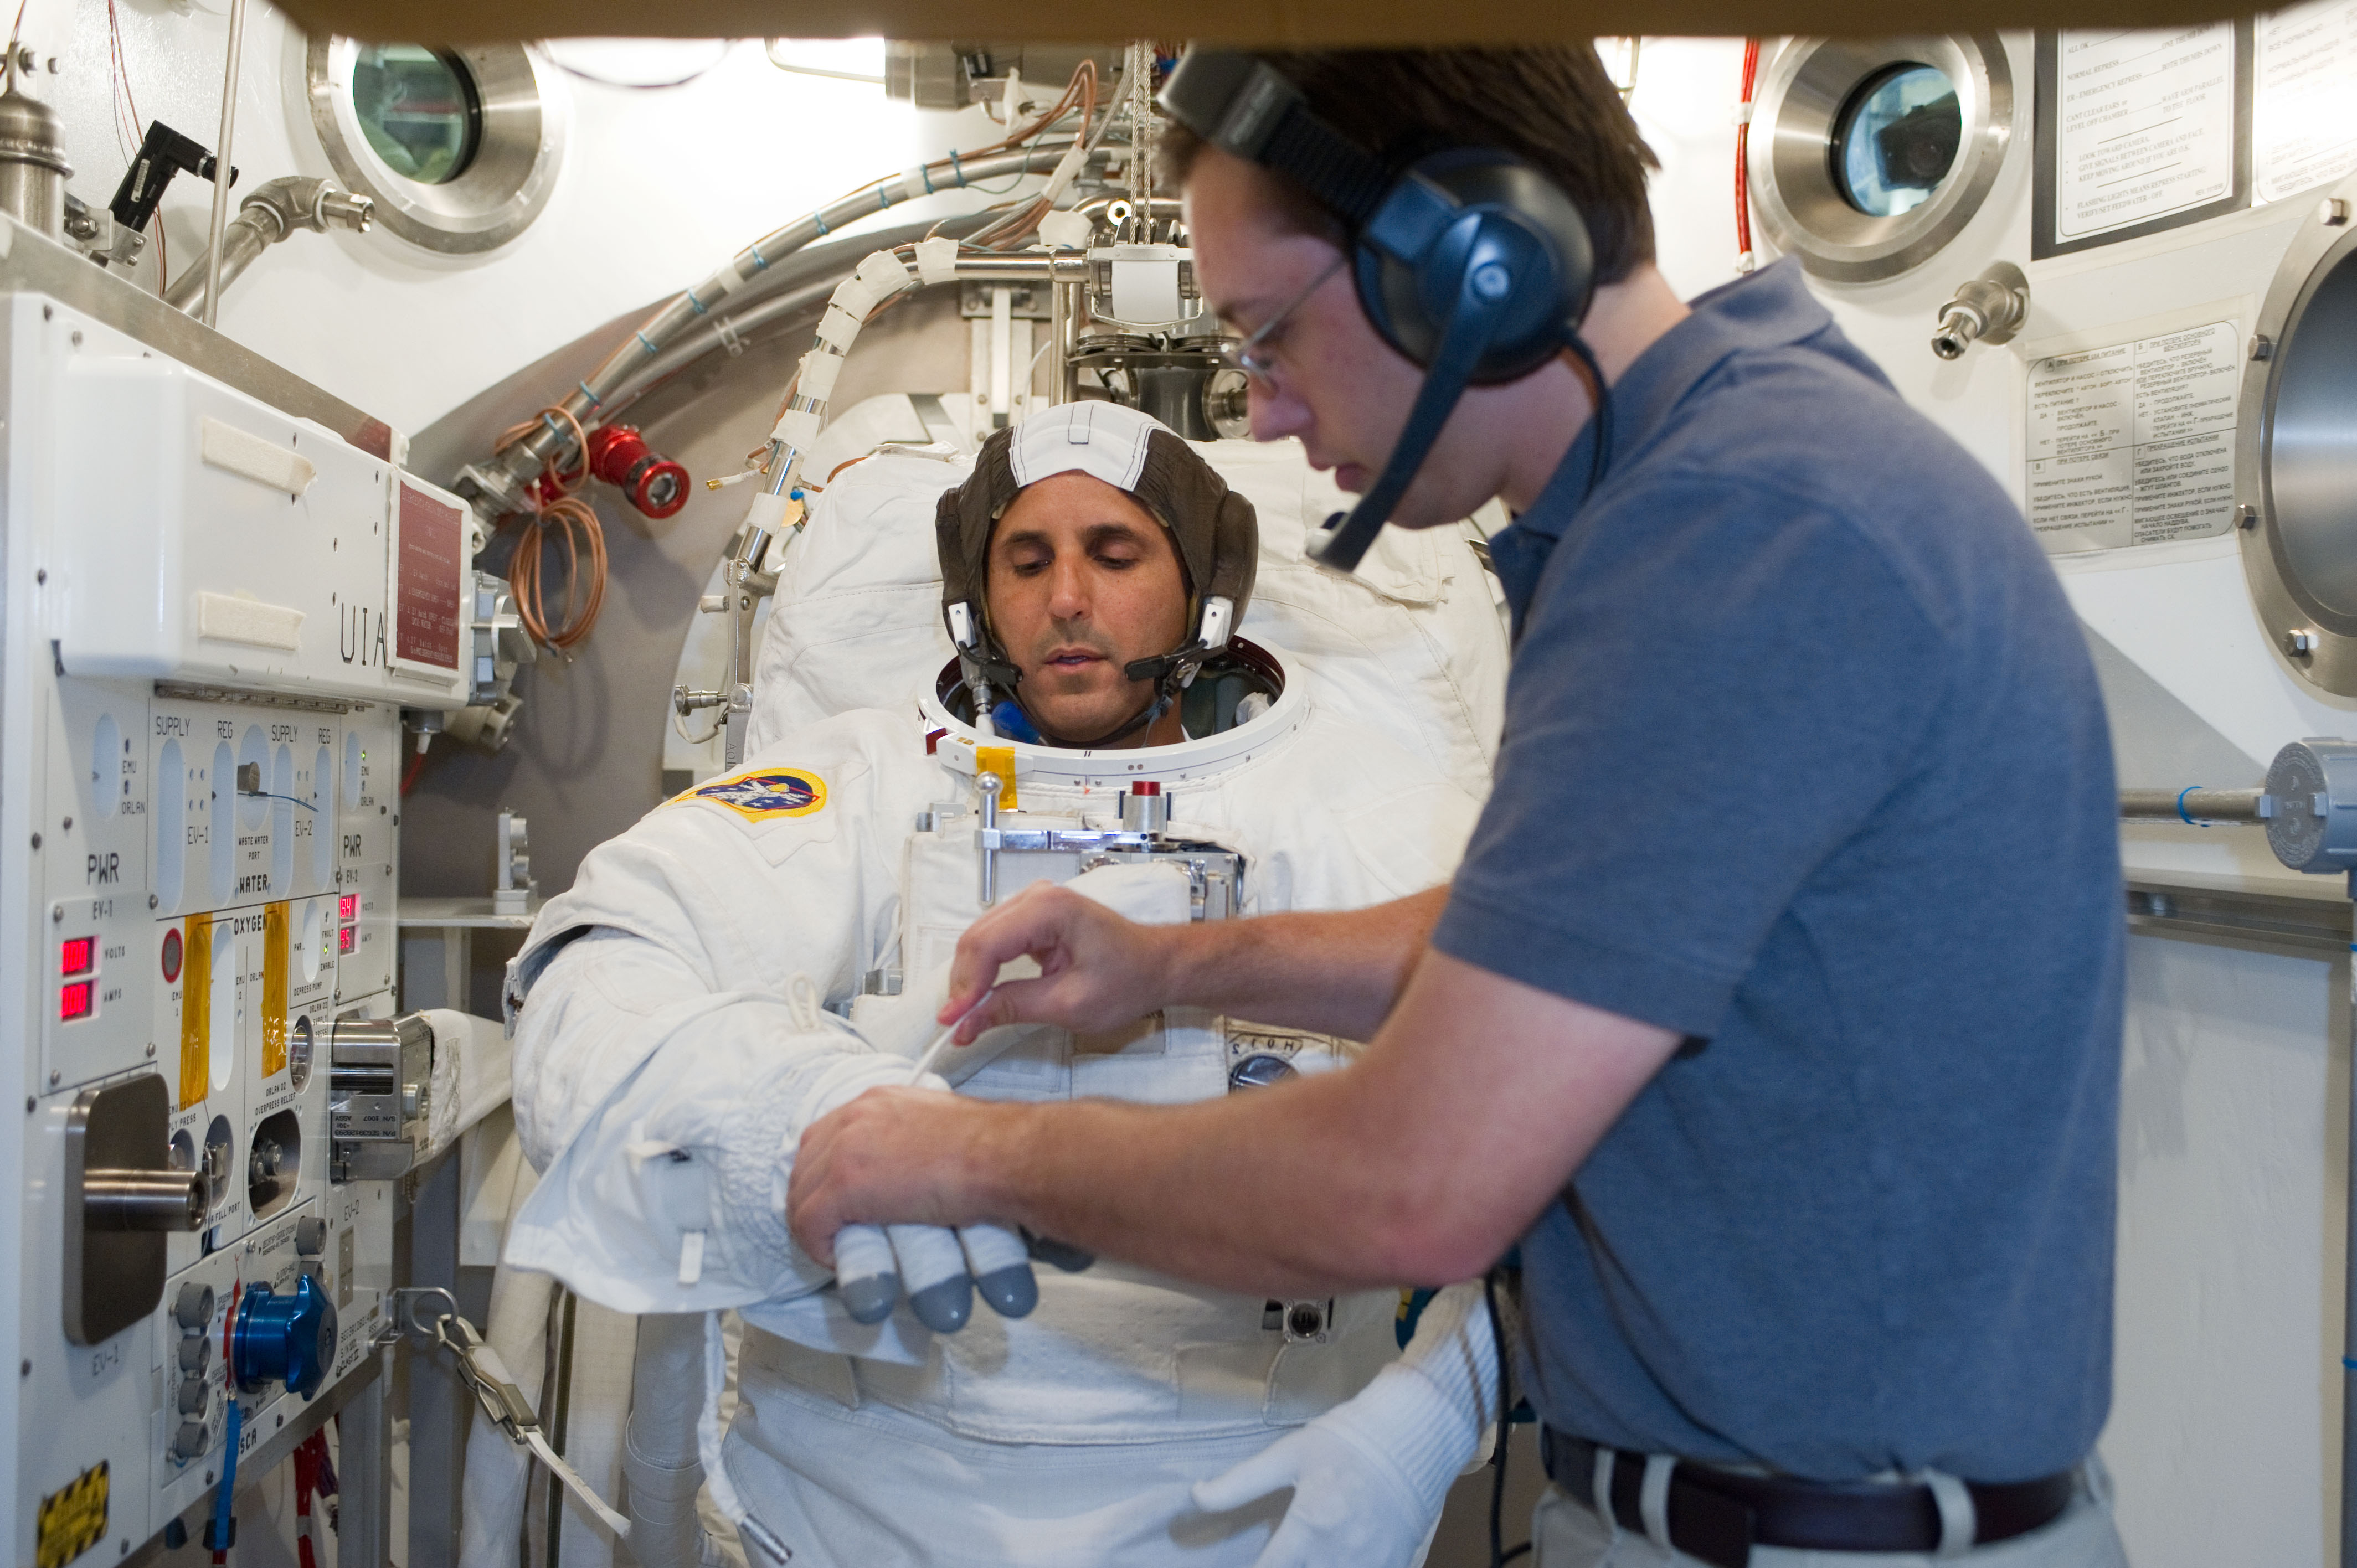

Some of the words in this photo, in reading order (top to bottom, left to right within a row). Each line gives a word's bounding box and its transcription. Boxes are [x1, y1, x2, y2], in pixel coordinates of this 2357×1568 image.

[341, 602, 386, 669] UIA
[156, 716, 190, 736] SUPPLY
[218, 720, 233, 739] REG
[272, 724, 298, 742] SUPPLY
[318, 728, 331, 744] REG
[123, 760, 136, 773] EMU
[122, 801, 145, 814] ORLAN
[361, 797, 374, 806] ORLAN
[187, 825, 208, 844] EV-1
[295, 820, 312, 837] EV-2
[239, 837, 253, 846] WASTE
[255, 835, 268, 844] WATER
[343, 834, 361, 858] PWR
[249, 851, 260, 860] PORT
[88, 853, 119, 885] PWR
[346, 869, 358, 884] EV-2
[240, 874, 267, 894] WATER
[93, 900, 112, 920] EV-1
[234, 914, 267, 935] OXYGEN
[322, 929, 333, 938] FAULT
[105, 946, 125, 960] VOLTS
[320, 961, 334, 971] ENABLE
[236, 975, 245, 986] EMU
[250, 972, 264, 983] ORLAN
[104, 988, 121, 1002] AMPS
[172, 990, 182, 1001] EMU
[239, 991, 242, 1000] 2
[294, 984, 311, 997] DEPRESS
[312, 981, 322, 991] PUMP
[309, 1003, 321, 1014] ORLAN
[313, 1015, 327, 1026] SUPPLY
[316, 1028, 327, 1038] PRESS
[266, 1085, 280, 1097] ORLAN
[255, 1098, 280, 1116] OVERPRESS
[280, 1092, 296, 1106] RELIEF
[180, 1113, 196, 1129] PRESS
[215, 1210, 227, 1221] FILL
[229, 1201, 240, 1215] PORT
[344, 1199, 359, 1221] EV-2
[93, 1344, 119, 1376] EV-1
